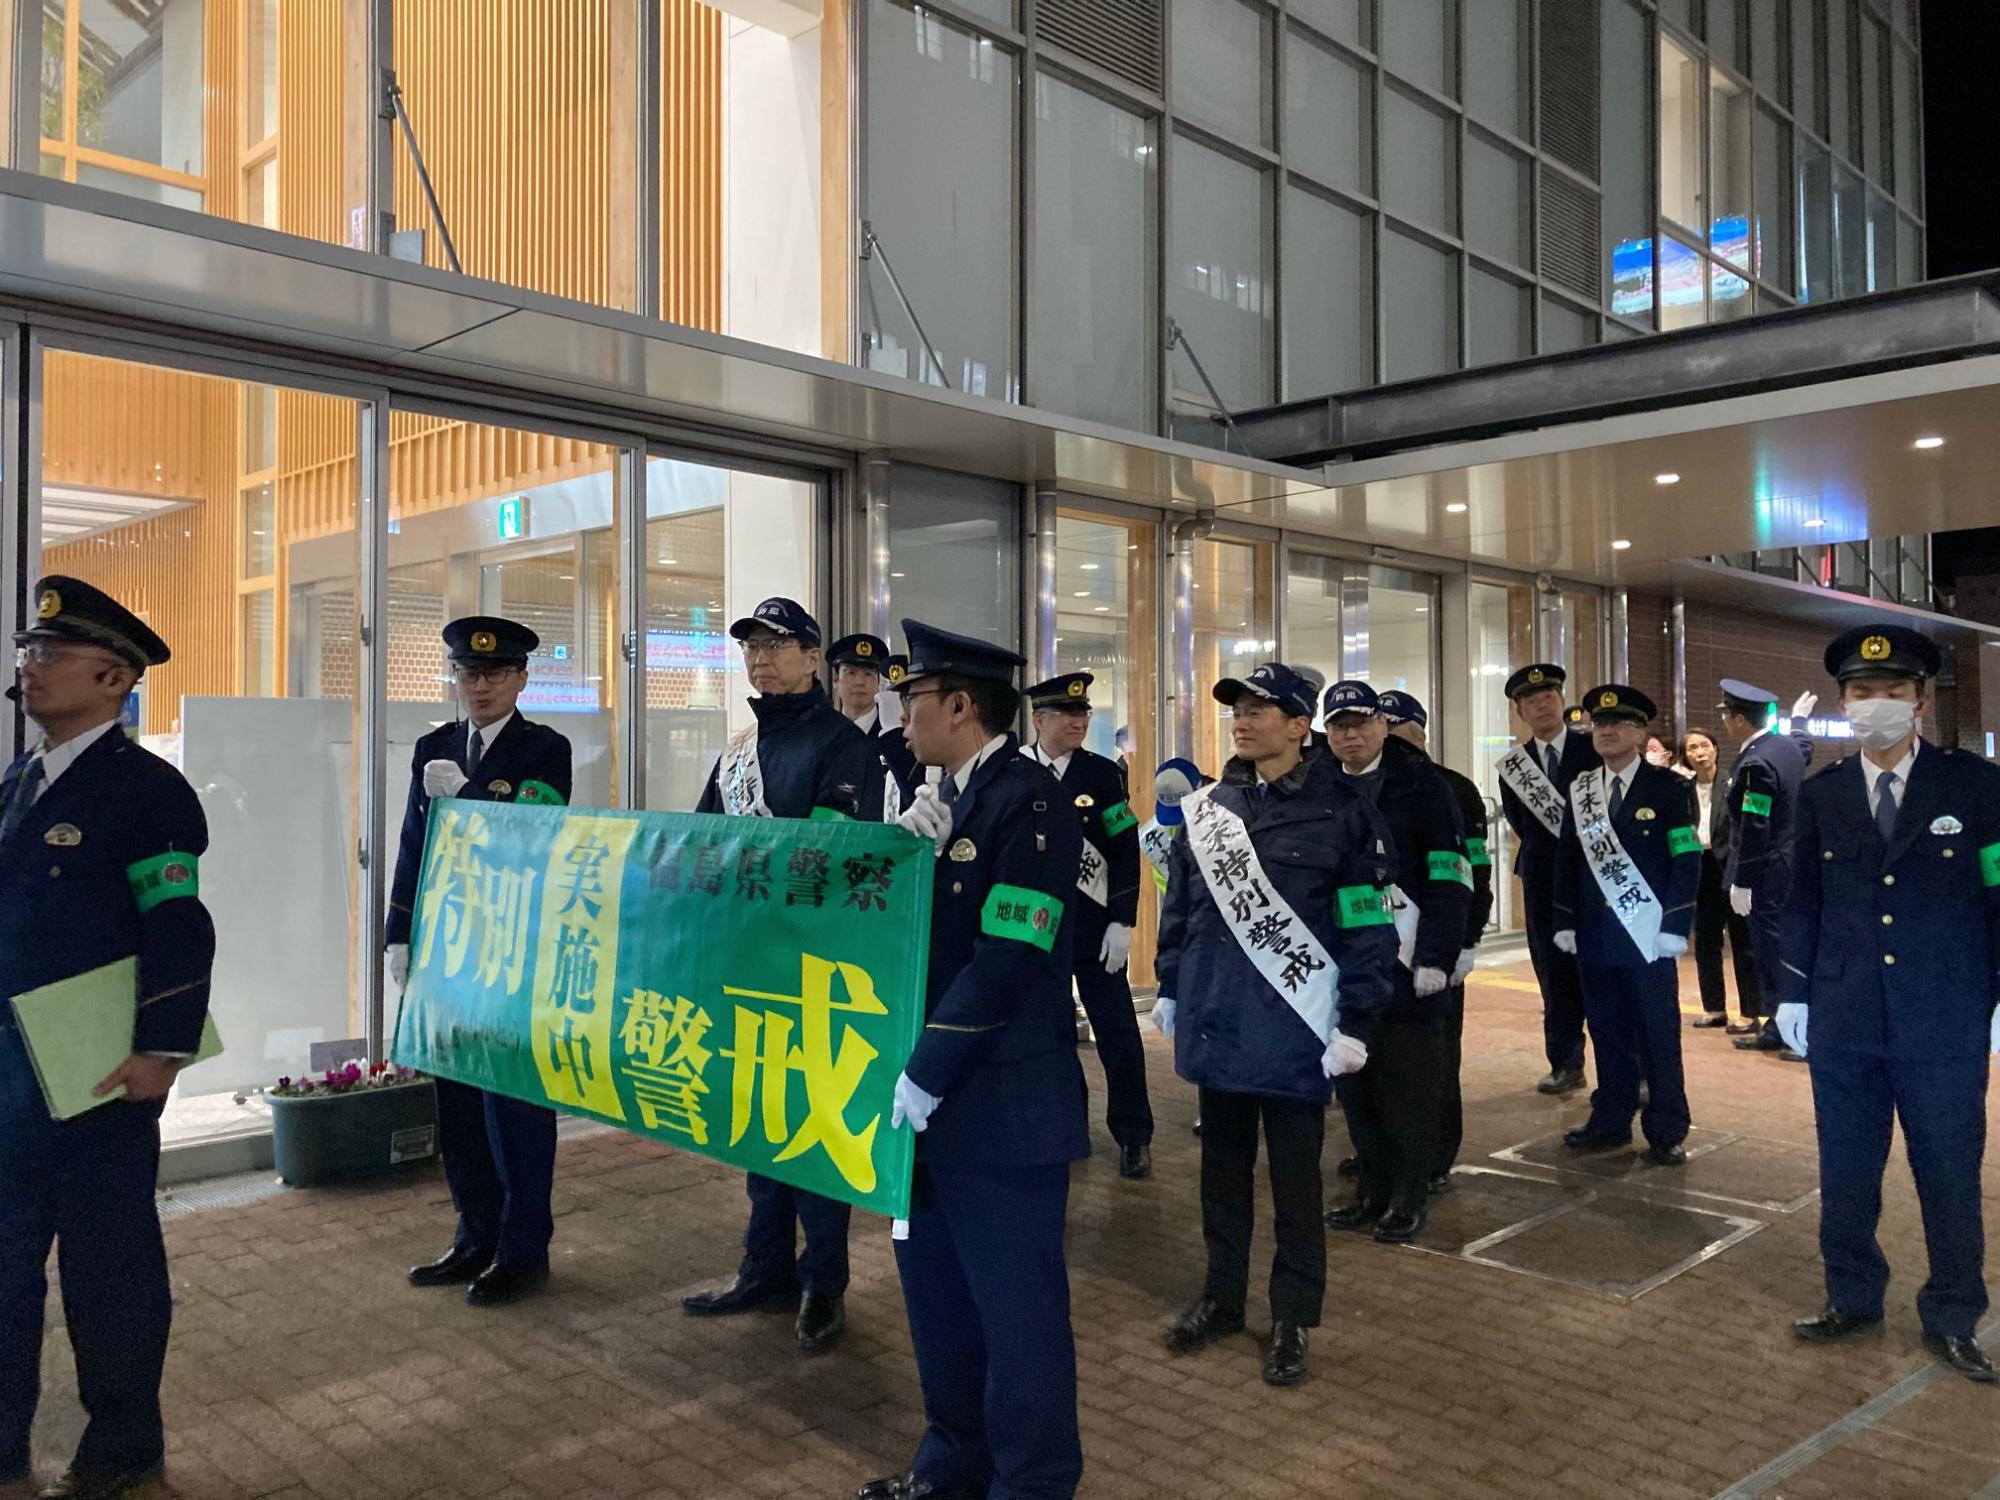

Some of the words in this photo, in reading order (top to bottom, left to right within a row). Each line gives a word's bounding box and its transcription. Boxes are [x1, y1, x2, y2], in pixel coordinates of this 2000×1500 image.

[1503, 753, 1566, 825] 年末特別
[1575, 771, 1652, 917] 年末特別警戒
[419, 808, 537, 995] 特別
[546, 839, 612, 1104] 実施中
[995, 899, 1031, 926] 地域
[1193, 798, 1327, 994] 年末特別警戒
[618, 951, 889, 1195] 警戒
